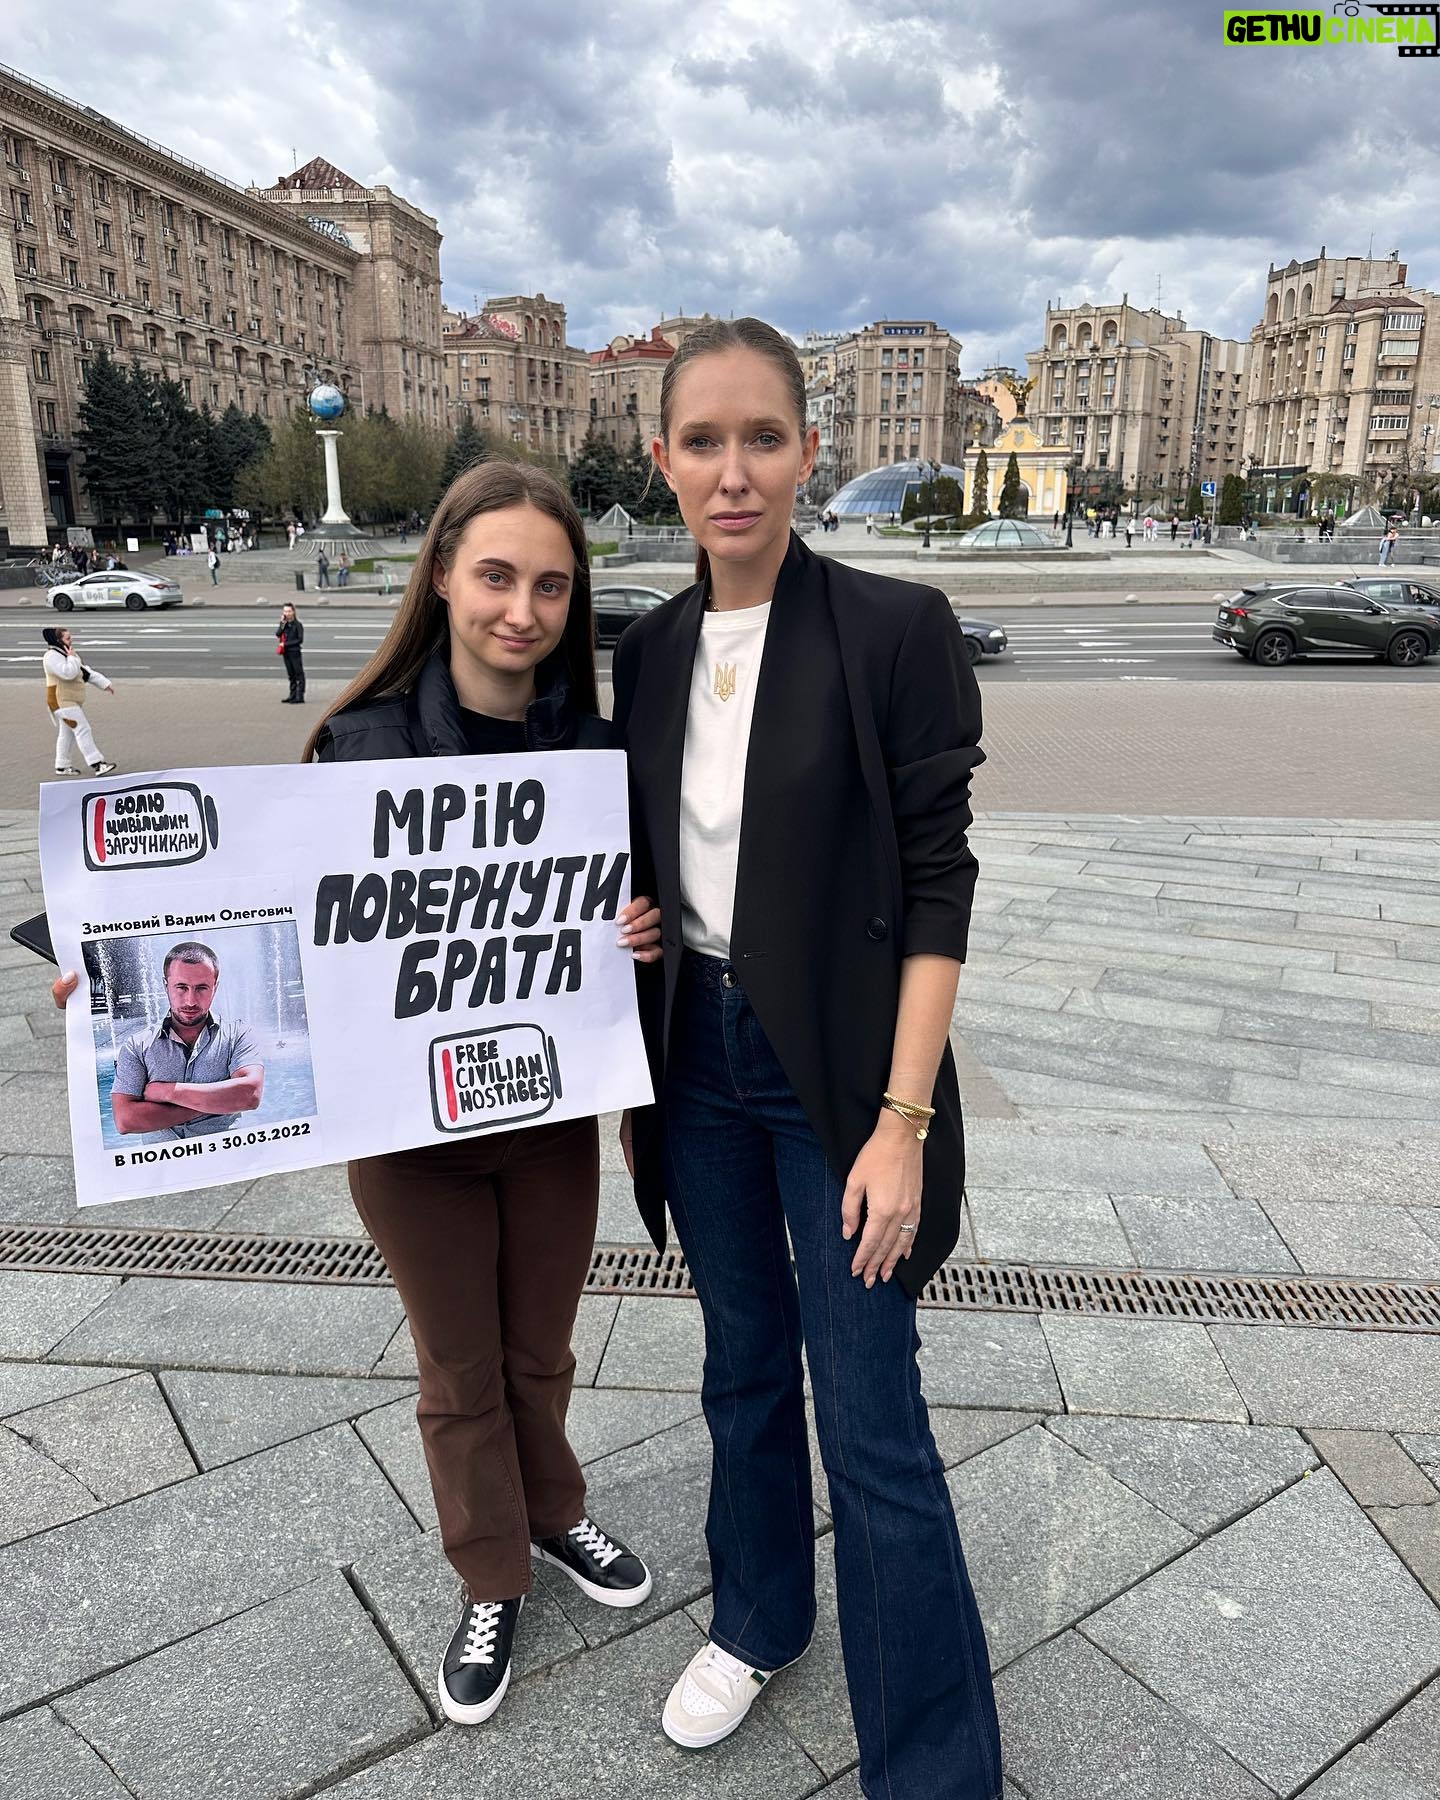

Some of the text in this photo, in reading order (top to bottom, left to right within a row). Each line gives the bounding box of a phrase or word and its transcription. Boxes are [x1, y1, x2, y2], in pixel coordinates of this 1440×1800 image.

[115, 793, 164, 815] ВОЛЮ
[105, 833, 199, 855] ЗАРУЧНИКАМ
[314, 852, 630, 946] ПОВЕРНУТИ
[82, 906, 293, 935] Замковий Вадим Олегович
[394, 929, 582, 1019] БРАТА
[455, 1039, 499, 1064] FREE
[455, 1053, 543, 1088] CIVILIAN
[459, 1076, 551, 1113] HOSTAGES
[115, 1155, 126, 1167] В
[131, 1143, 203, 1165] ПОЛОНІ
[222, 1122, 311, 1150] 30.03.2022
